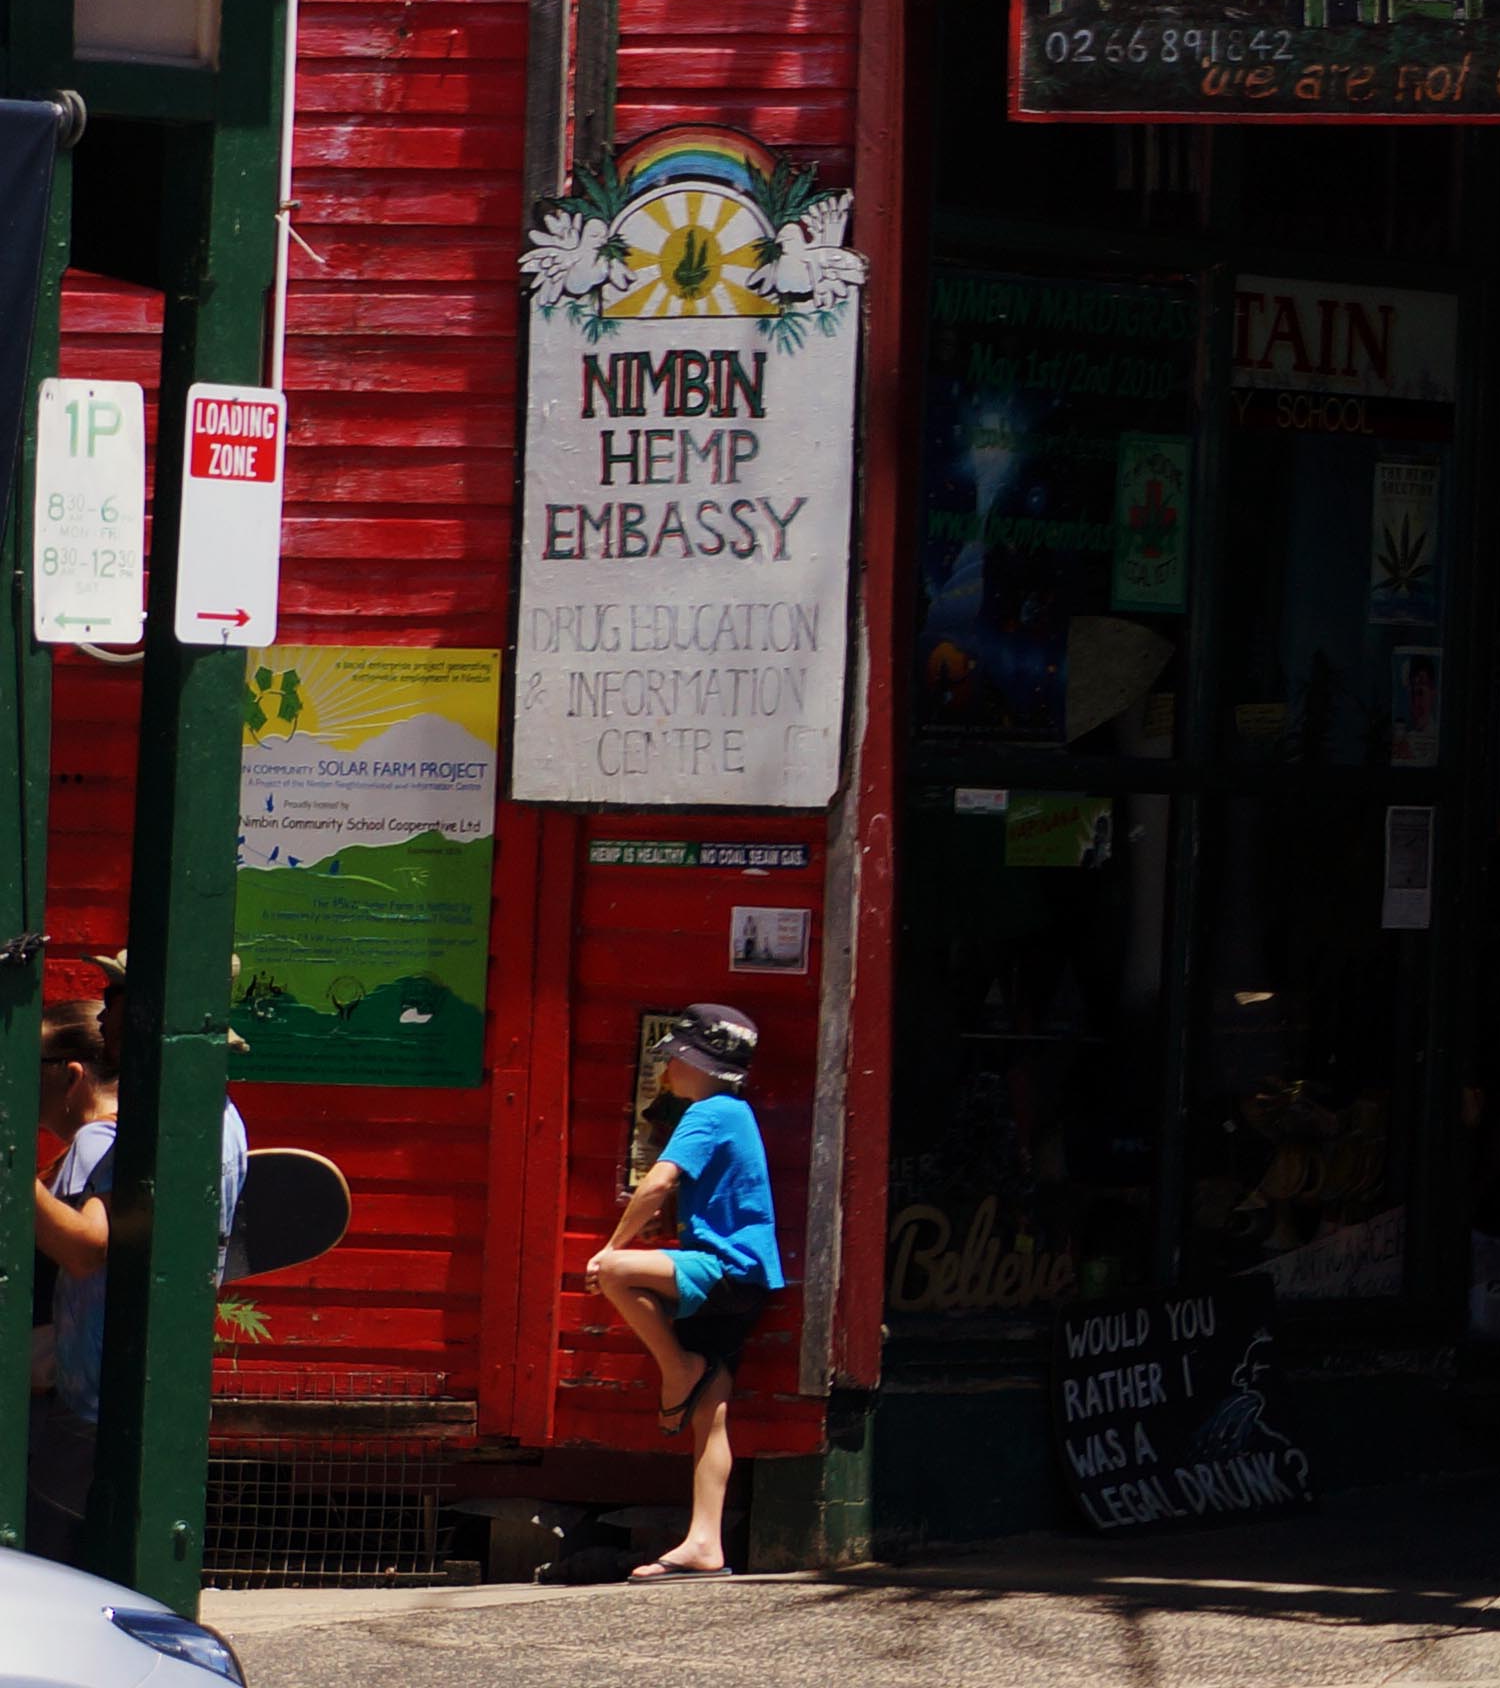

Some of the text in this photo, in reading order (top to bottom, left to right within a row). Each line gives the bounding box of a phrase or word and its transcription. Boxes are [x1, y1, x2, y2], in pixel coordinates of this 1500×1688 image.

[1294, 64, 1375, 102] are
[1394, 50, 1472, 102] not
[933, 279, 1032, 326] NIMBIN
[581, 349, 768, 419] NIMBIN
[65, 399, 122, 458] 1P
[196, 402, 277, 440] LOADING
[1278, 392, 1375, 434] SCHOOL
[208, 443, 258, 478] ZONE
[599, 428, 760, 486] HEMP
[541, 496, 808, 561] EMBASSY
[531, 601, 821, 655] DRUG EDUCATION
[523, 666, 808, 719] & INFORMATION
[253, 765, 314, 776] COMMUNITY
[318, 760, 368, 777] SOLAR
[373, 763, 415, 777] FARM
[420, 762, 488, 783] PROJECT
[597, 727, 745, 777] CENTRE
[281, 817, 342, 832] Community
[347, 818, 385, 831] School
[388, 819, 457, 834] Cooperative
[460, 820, 481, 832] Ltd
[590, 847, 686, 864] HEMP IS HEALTHY
[700, 849, 716, 865] NO
[718, 849, 747, 865] COAL
[1065, 1295, 1216, 1360] WOULD YOU
[1063, 1351, 1193, 1423] RATHER I
[1064, 1420, 1158, 1479] WAS A
[1080, 1474, 1188, 1528] LEGAL
